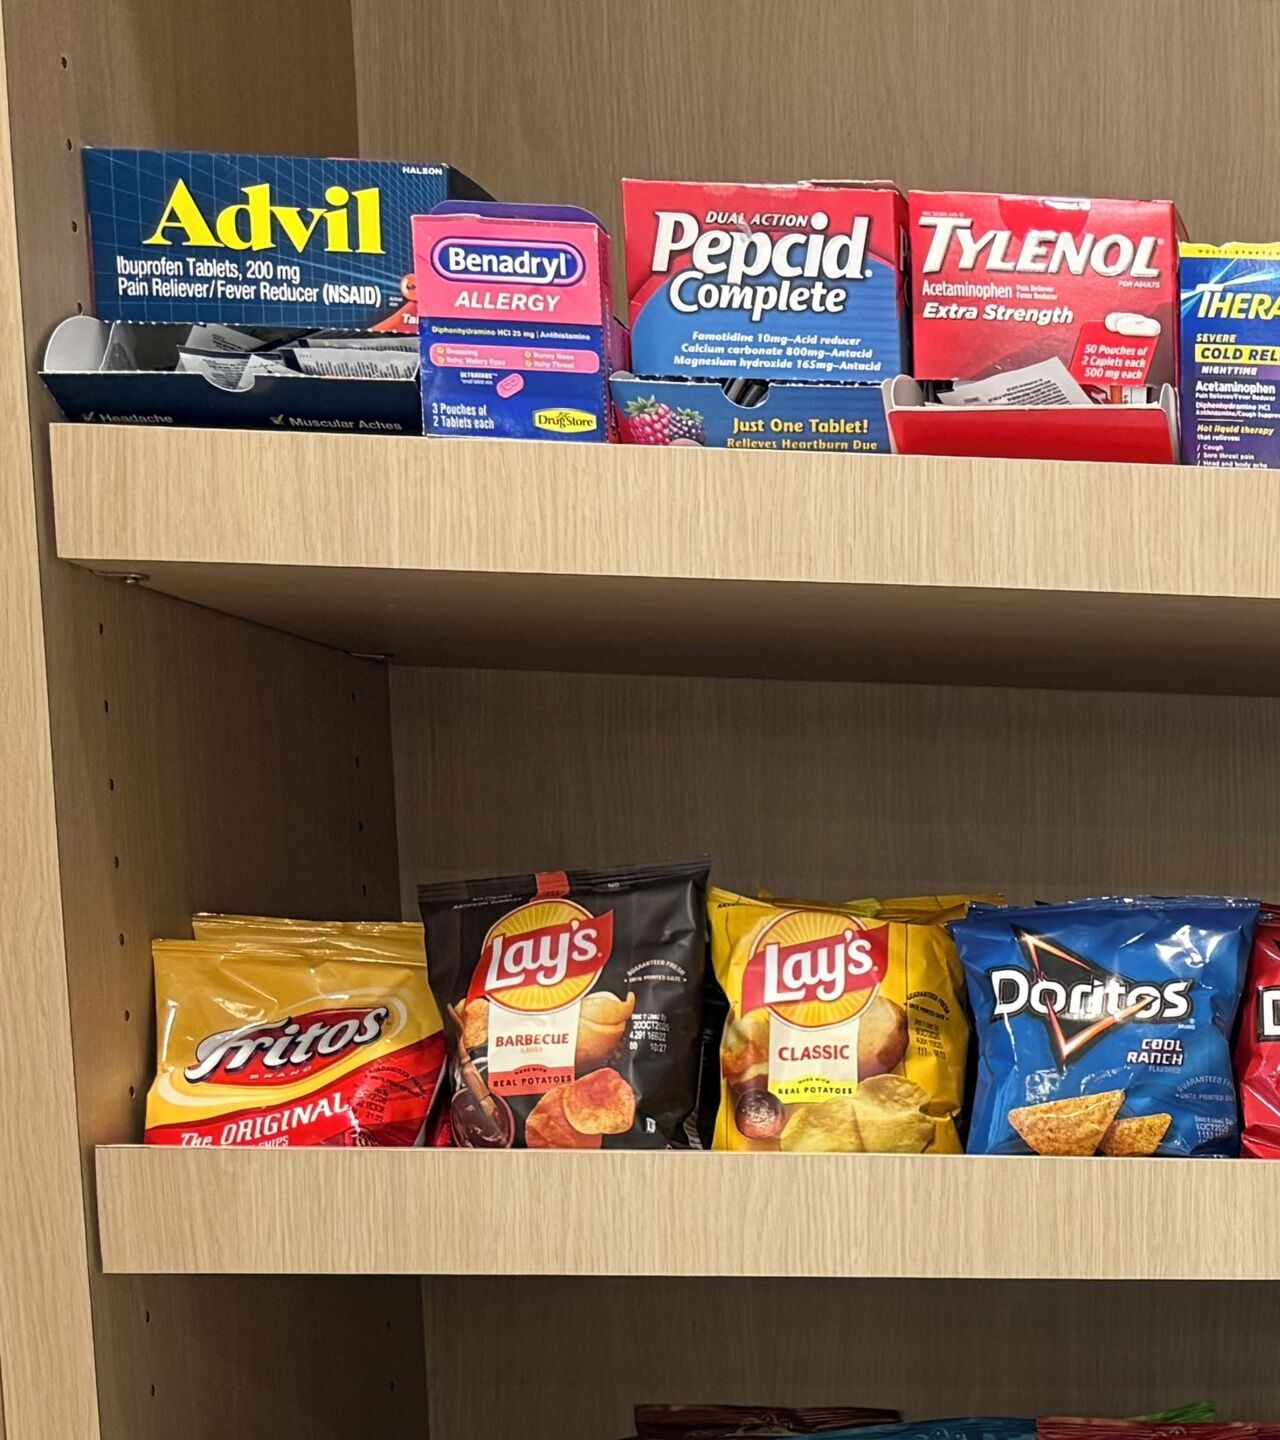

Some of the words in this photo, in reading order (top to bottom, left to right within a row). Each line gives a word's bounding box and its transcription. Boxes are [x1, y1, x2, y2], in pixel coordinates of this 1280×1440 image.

[402, 165, 443, 177] HALEON
[142, 177, 386, 256] Advil
[704, 209, 746, 226] DUAL
[749, 212, 808, 229] ACTION
[916, 215, 1158, 279] TYLENOL
[117, 256, 183, 278] Ibuprofen
[187, 256, 243, 279] Tablets,
[246, 261, 273, 279] 200
[277, 264, 300, 285] mg
[447, 246, 572, 284] Benadryl
[118, 277, 148, 297] Pain
[152, 279, 256, 301] Reliever/Fever
[260, 282, 319, 303] Reducer
[322, 283, 382, 308] (NSAID)
[669, 270, 847, 322] Complete
[921, 279, 1013, 300] Acetaminophen
[454, 290, 562, 313] ALLERGY
[922, 301, 979, 321] Extra
[982, 304, 1075, 326] Strength
[1196, 333, 1237, 343] SEVERE
[1199, 347, 1246, 364] COLD
[1195, 381, 1276, 395] Acetaminophen
[733, 418, 760, 434] Just
[764, 418, 802, 434] One
[807, 418, 870, 434] Tablet!
[484, 920, 602, 993] Lay's
[762, 929, 875, 1004] Lay's
[989, 968, 1193, 1020] Doritos
[184, 1005, 390, 1084] Fritos
[495, 1032, 570, 1048] BARBECUE
[1141, 1038, 1183, 1053] COOL
[777, 1044, 851, 1064] CLASSIC
[1126, 1050, 1184, 1066] RANCH
[493, 1077, 517, 1088] REAL
[520, 1075, 573, 1087] POTATOES
